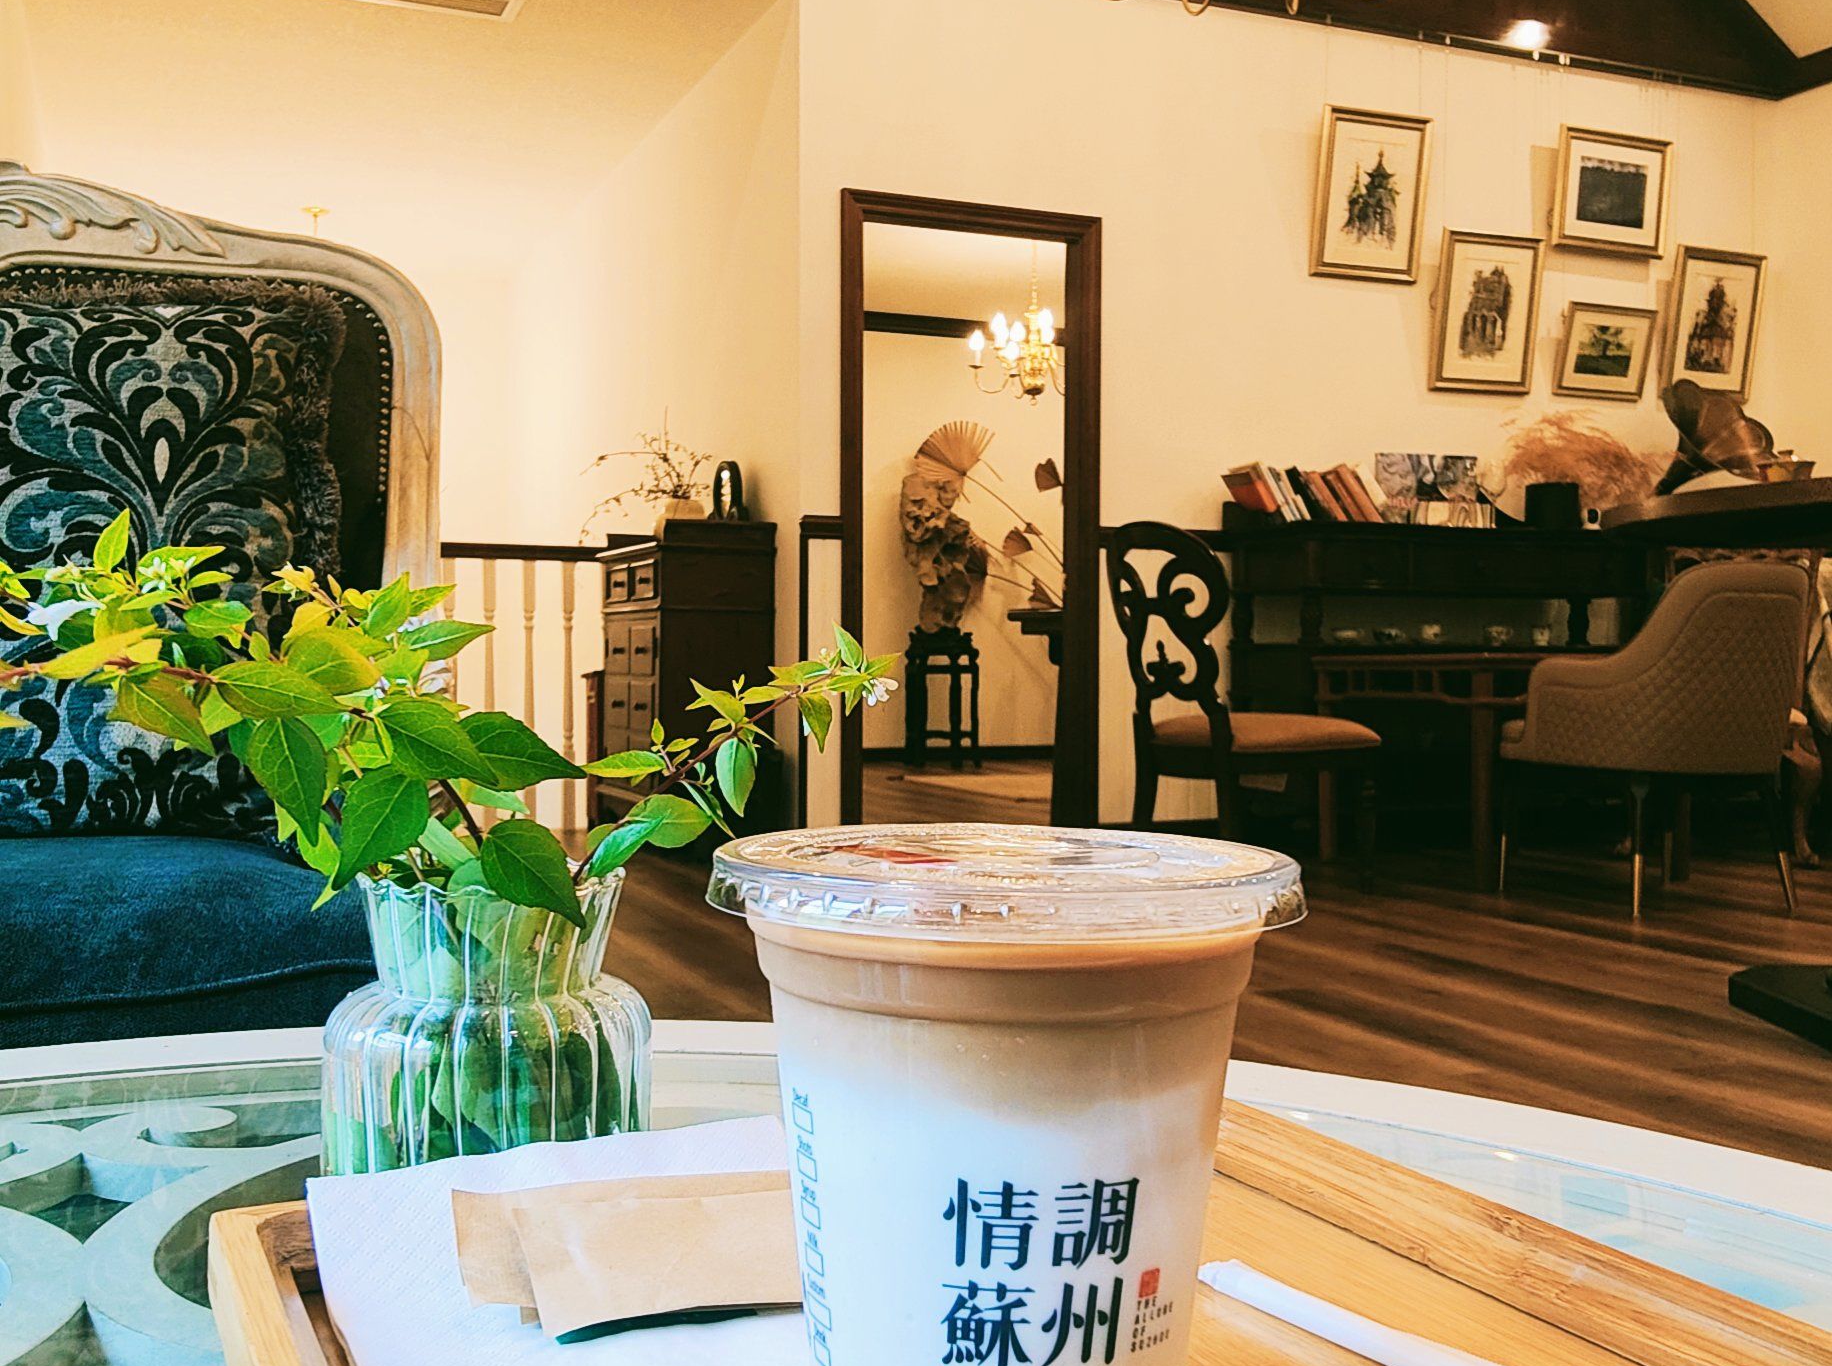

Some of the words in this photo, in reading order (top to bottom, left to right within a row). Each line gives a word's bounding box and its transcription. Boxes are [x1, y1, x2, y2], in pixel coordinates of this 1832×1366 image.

[942, 1177, 1140, 1271] 情調
[1137, 1296, 1158, 1311] THE
[1132, 1325, 1146, 1339] OF
